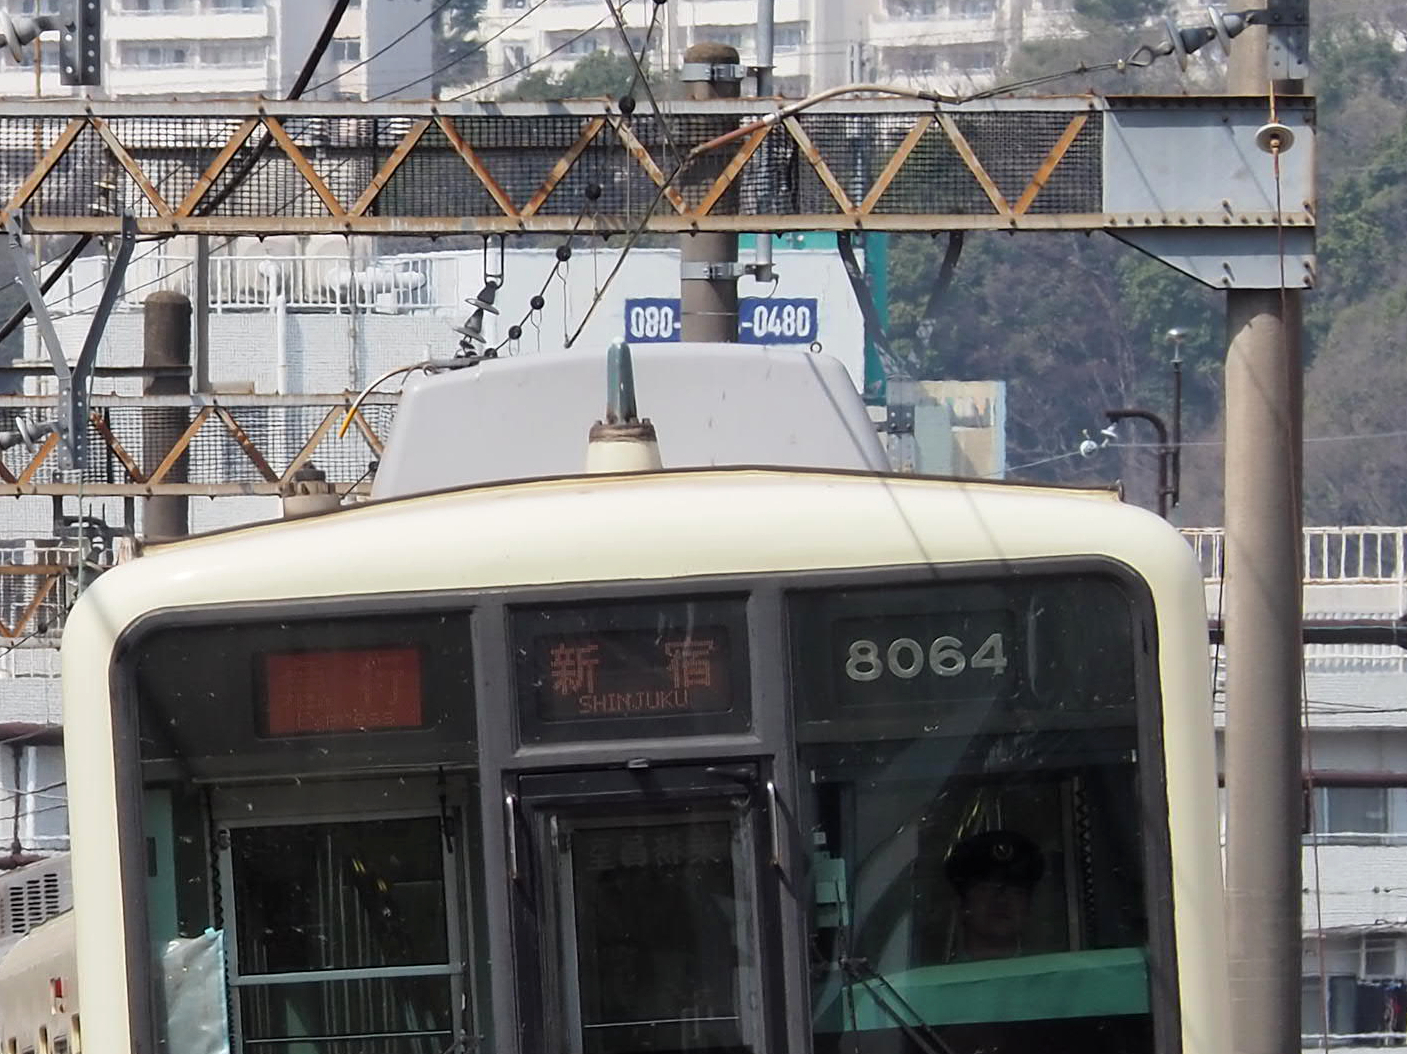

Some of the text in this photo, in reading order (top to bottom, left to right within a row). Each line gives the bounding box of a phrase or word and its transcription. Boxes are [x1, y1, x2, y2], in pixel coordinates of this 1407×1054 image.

[739, 305, 811, 337] -0480
[550, 639, 715, 695] 新宿
[846, 633, 1008, 681] 8064
[578, 688, 689, 714] SHINJUKU
